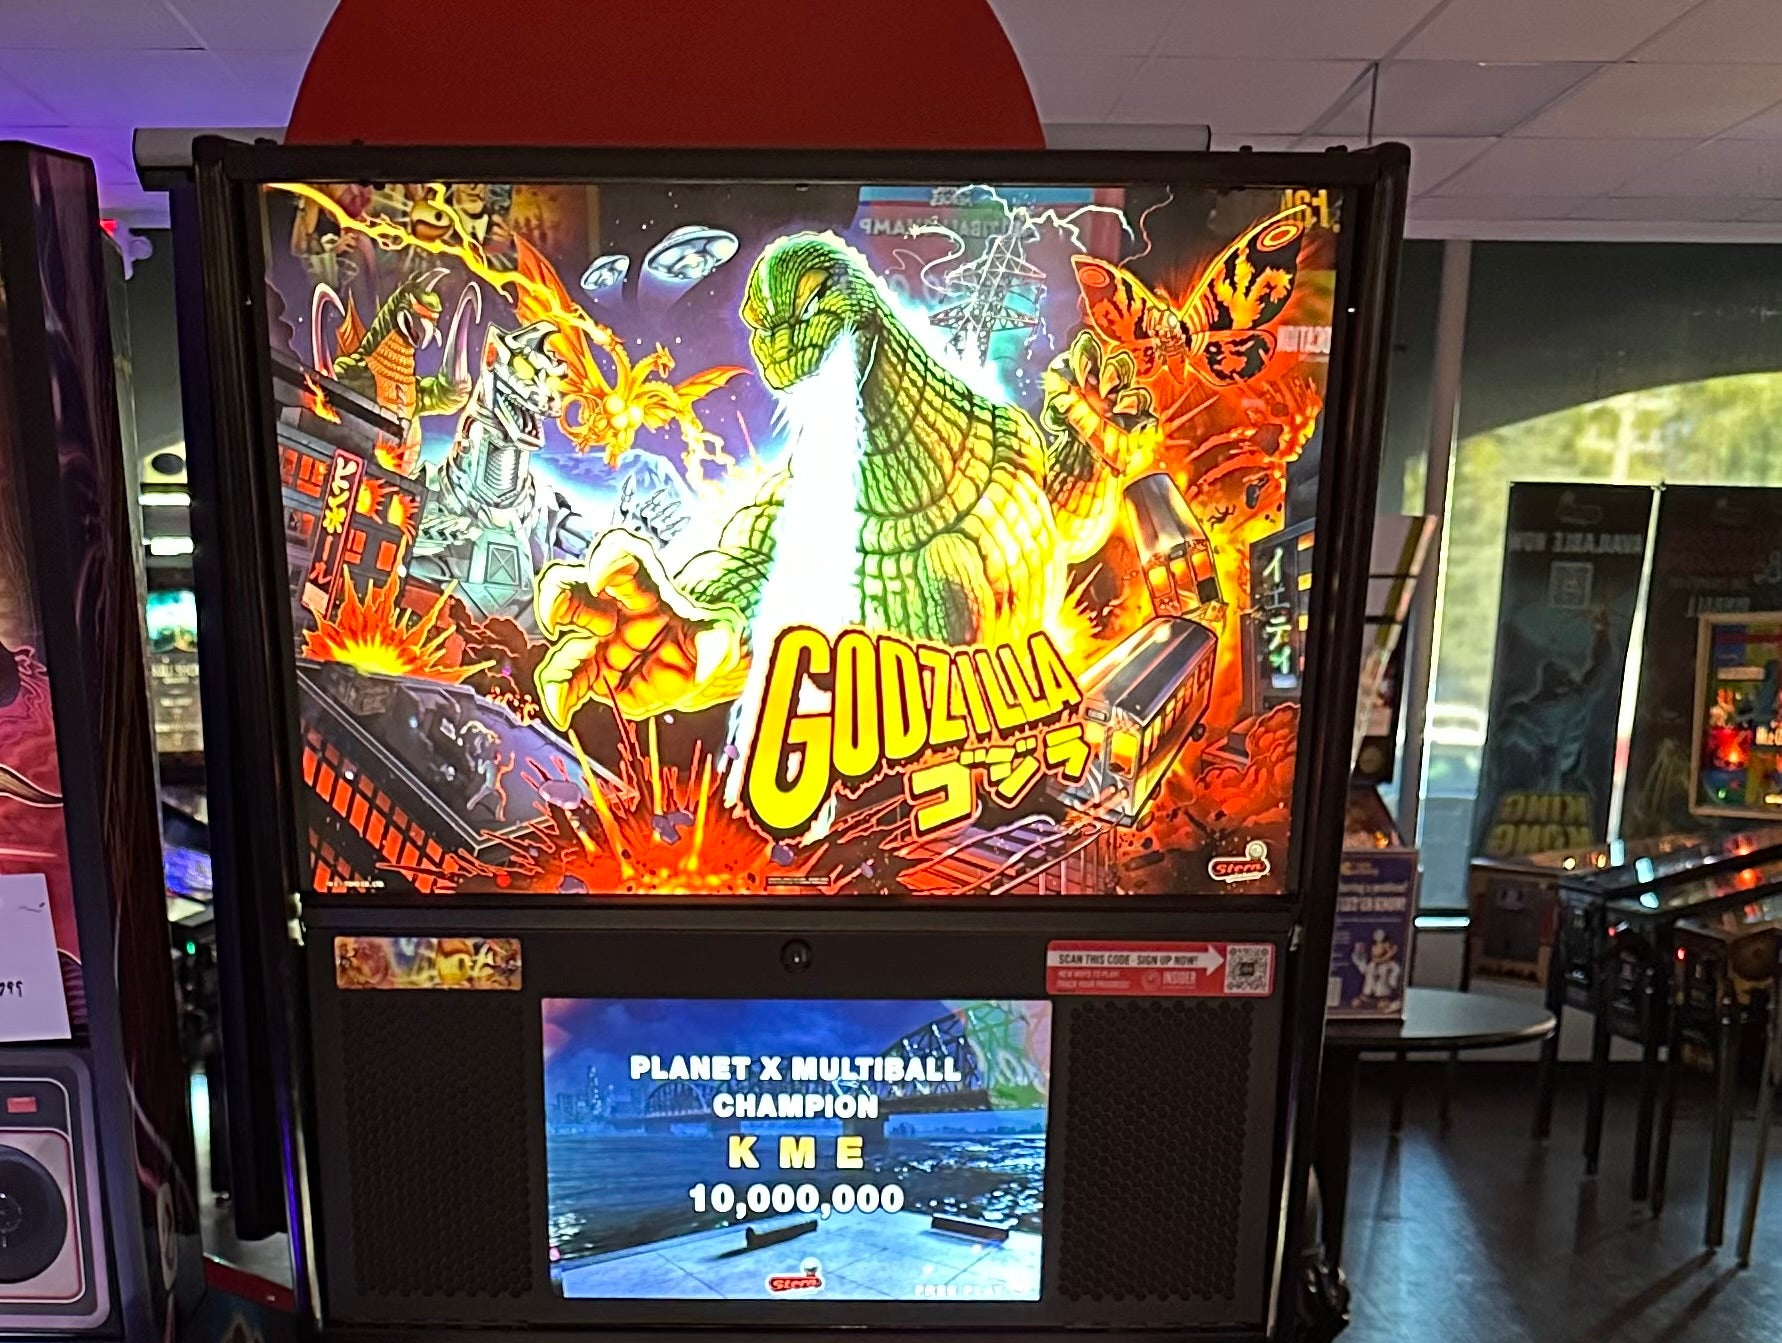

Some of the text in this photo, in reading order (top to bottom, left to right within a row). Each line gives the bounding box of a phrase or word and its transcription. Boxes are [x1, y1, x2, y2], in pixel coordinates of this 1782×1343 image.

[749, 631, 1082, 828] GODZILLA
[912, 723, 1088, 830] ゴジラ
[1216, 862, 1263, 875] Stern
[1059, 953, 1083, 965] SCAN
[1085, 954, 1105, 965] THIS
[1107, 954, 1130, 965] CODE
[1137, 955, 1157, 965] SIGN
[1160, 955, 1172, 965] UP
[1163, 971, 1196, 985] INSIDER
[630, 1055, 961, 1082] PLANET X MULTIBALL
[712, 1094, 878, 1119] CHAMPION
[727, 1134, 865, 1169] K M E
[688, 1182, 905, 1219] 10,000,000
